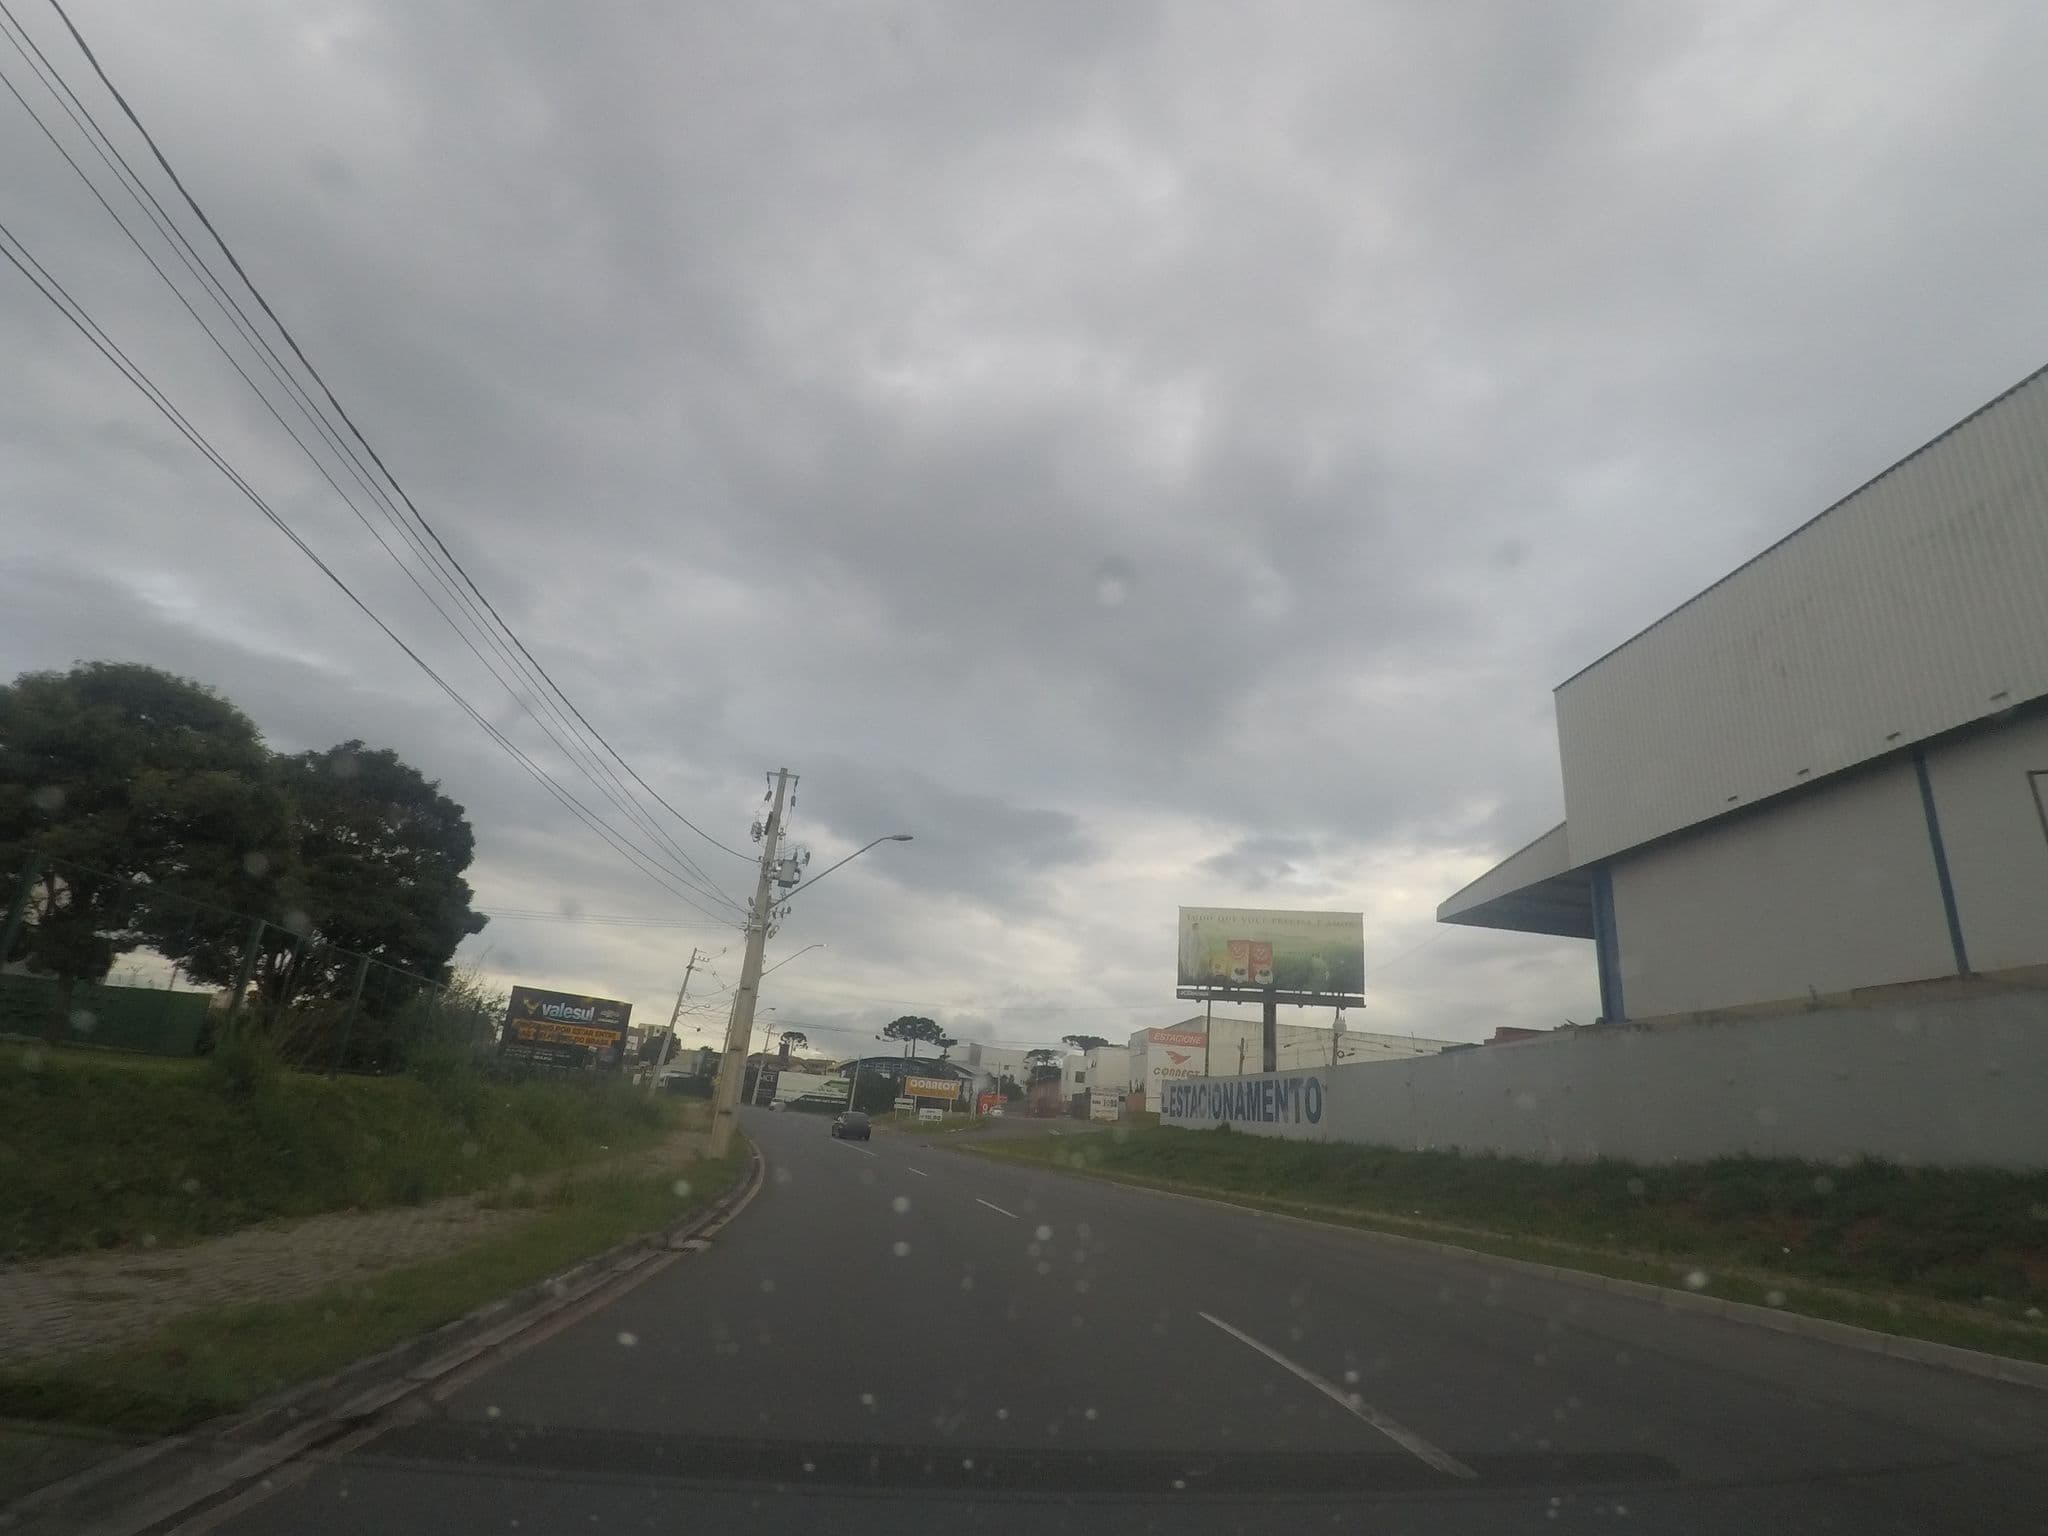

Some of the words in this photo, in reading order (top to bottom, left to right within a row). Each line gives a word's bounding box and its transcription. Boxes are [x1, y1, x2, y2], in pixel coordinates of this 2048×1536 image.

[542, 1003, 595, 1021] valesul
[1153, 1031, 1201, 1045] ESTACIONE
[1169, 1076, 1322, 1124] ESTACIONAMENTO
